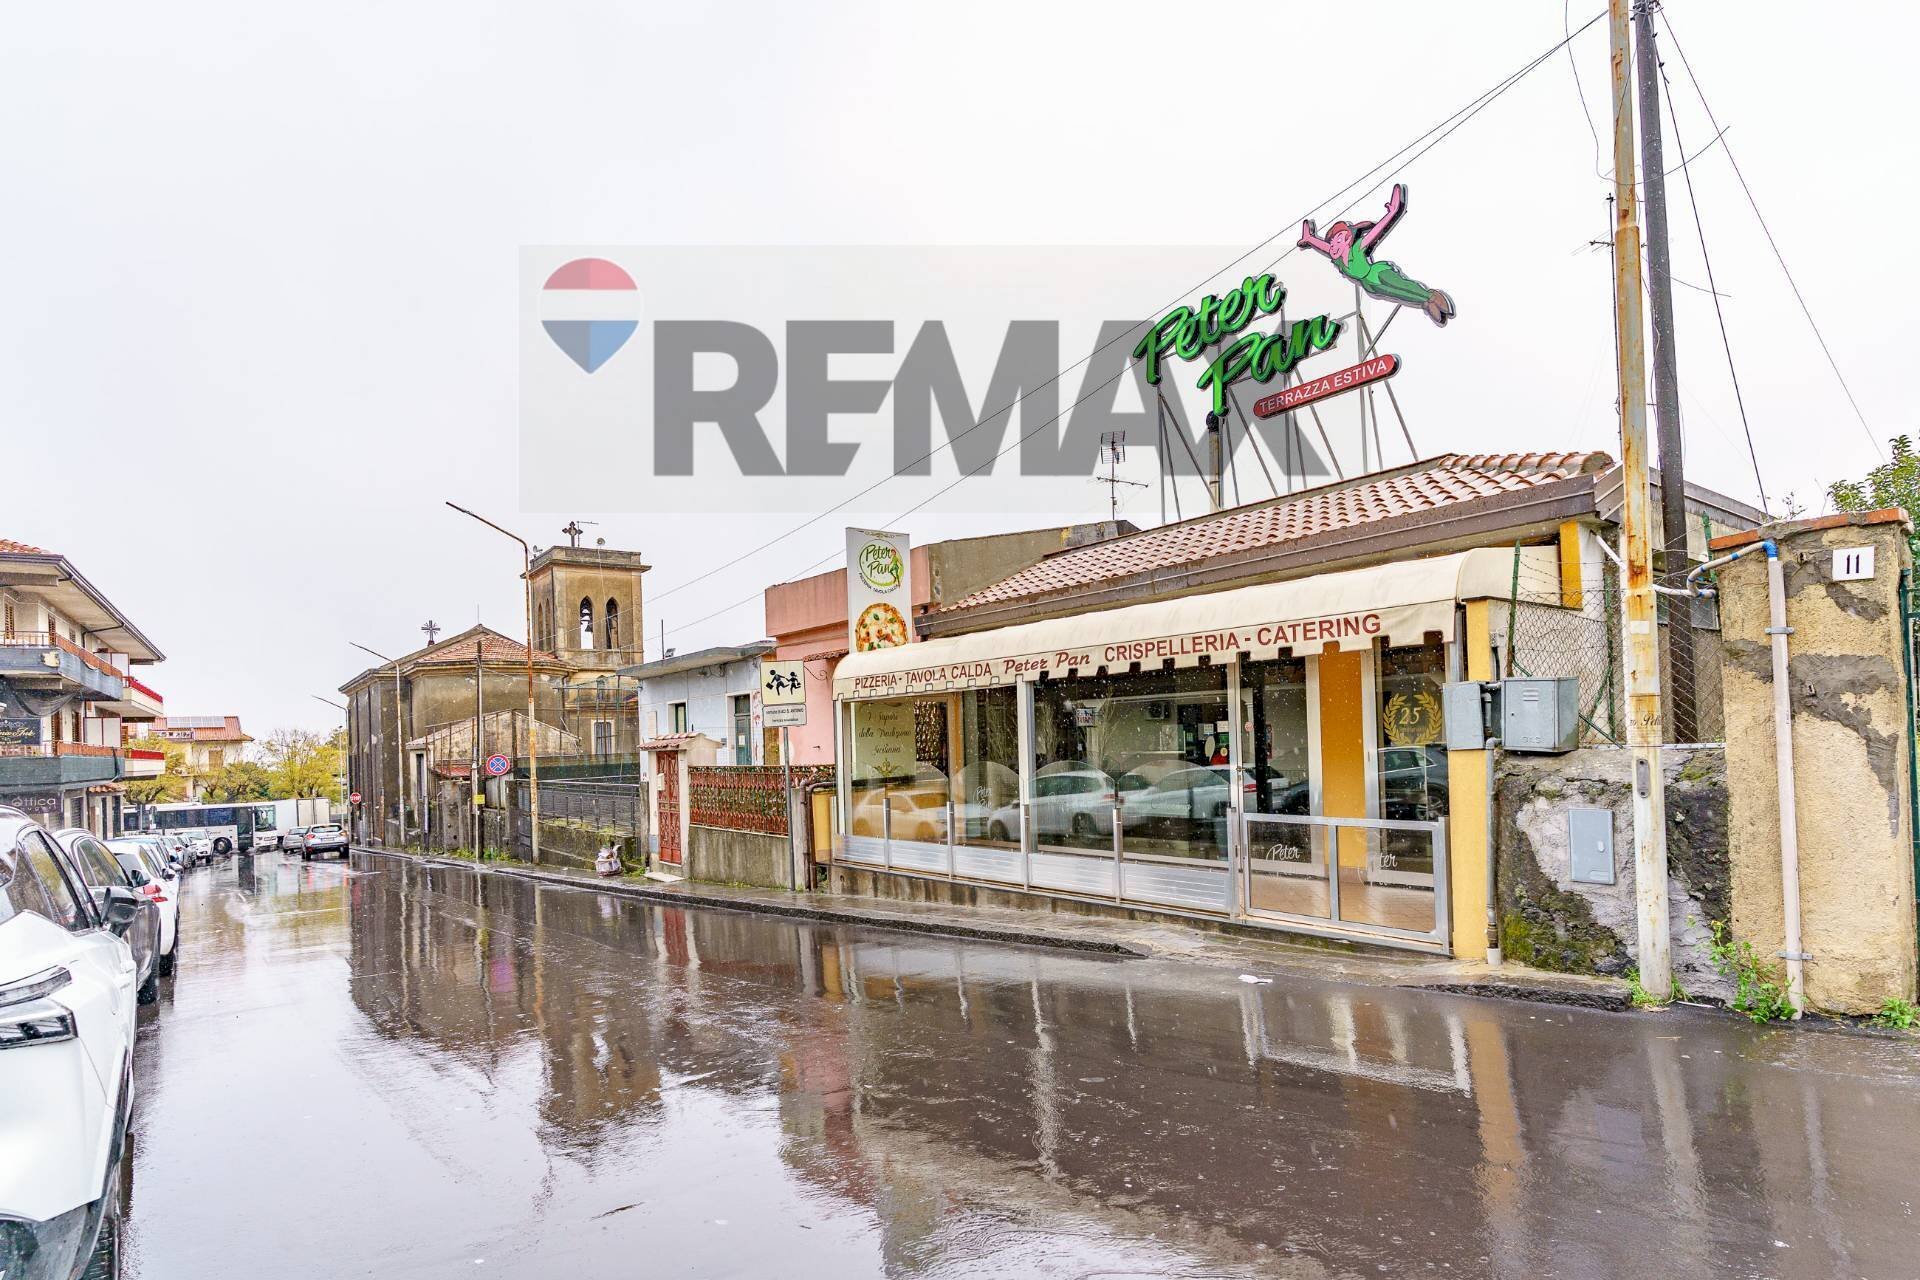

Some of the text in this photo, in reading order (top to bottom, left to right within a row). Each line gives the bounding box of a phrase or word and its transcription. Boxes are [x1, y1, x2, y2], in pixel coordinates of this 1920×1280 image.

[1133, 273, 1287, 384] Peter
[1197, 314, 1342, 416] Pan
[1259, 359, 1388, 413] TERRAZZA ESTIVA
[865, 544, 892, 562] Peter
[1845, 553, 1861, 575] 11
[867, 560, 892, 578] Pan
[855, 674, 898, 689] PIZZERIA
[905, 667, 947, 684] TAVOLA
[951, 662, 993, 680] CALDA
[1003, 656, 1048, 674] Peter
[1055, 651, 1091, 668] Pan
[1104, 631, 1240, 662] CRISPELLERIA
[1257, 613, 1381, 646] CATERING
[1399, 706, 1422, 725] 25
[1266, 842, 1301, 862] Peter
